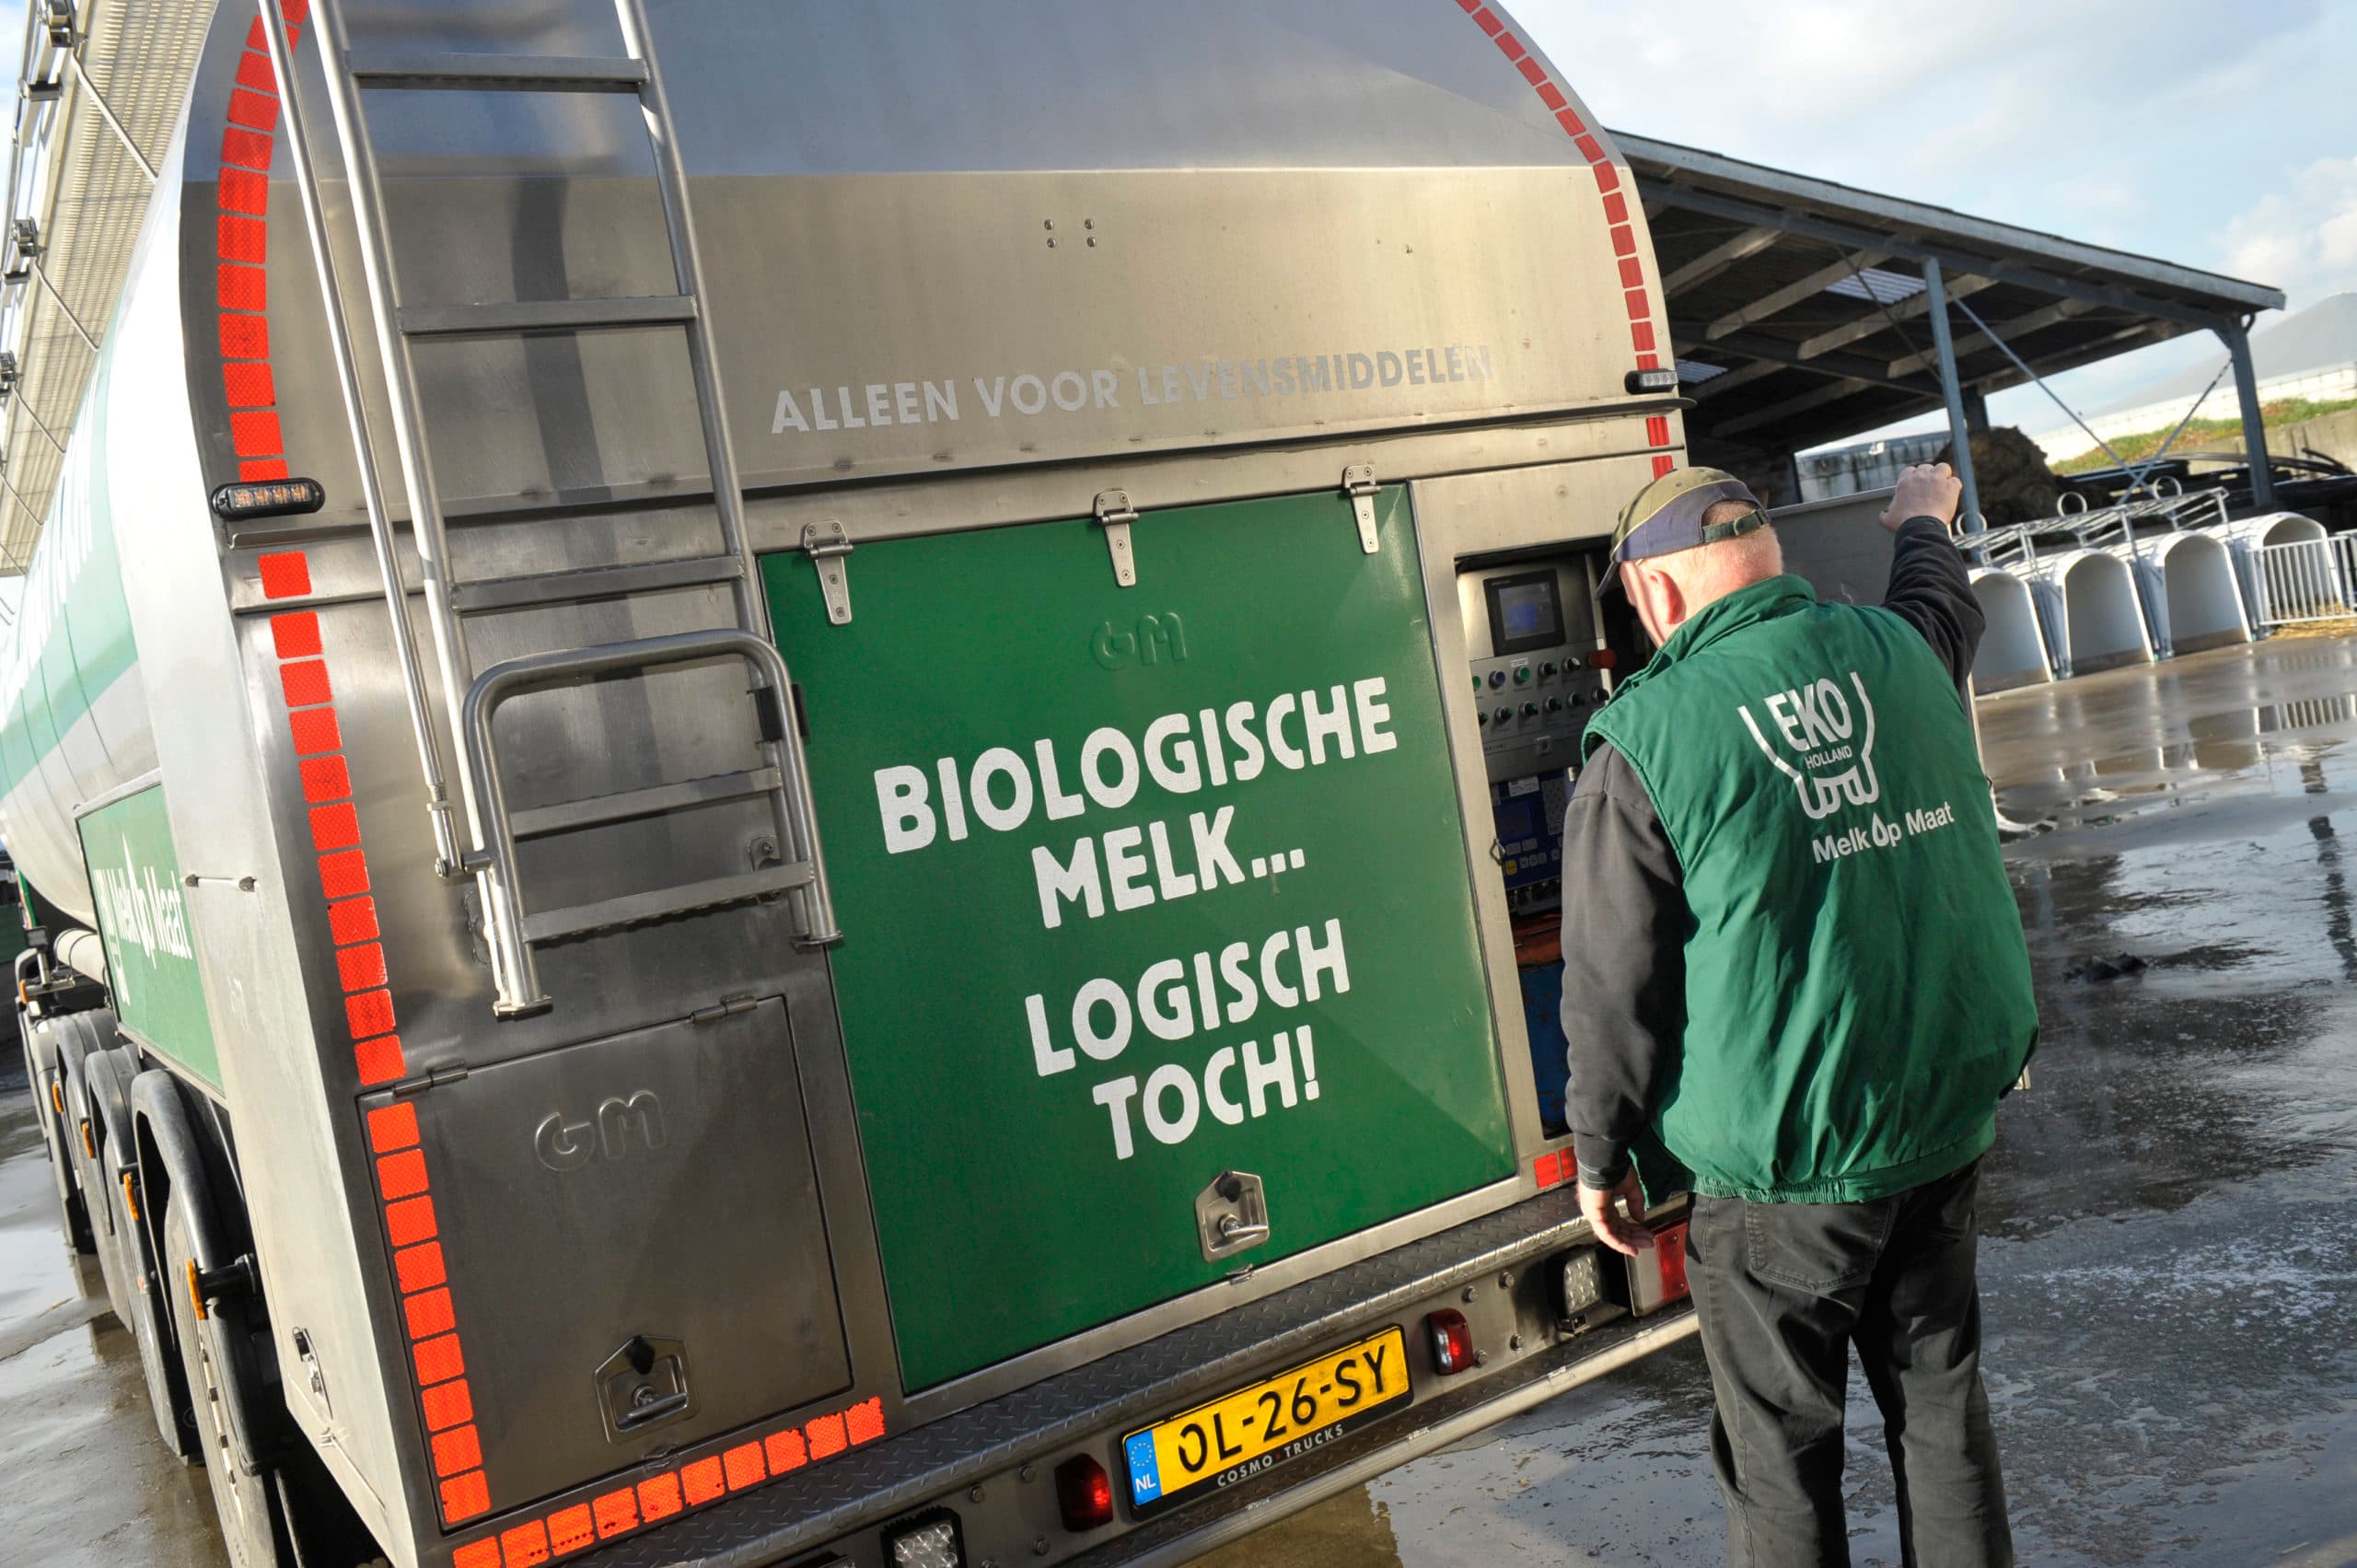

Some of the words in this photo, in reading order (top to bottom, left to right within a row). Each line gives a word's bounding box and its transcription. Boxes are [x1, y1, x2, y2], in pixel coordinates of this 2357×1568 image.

[771, 378, 960, 435] ALLEEN
[973, 369, 1120, 419] VOOR
[1137, 343, 1492, 406] LEVENSMIDDELEN
[1763, 678, 1853, 752] EKO
[1805, 745, 1853, 770] HOLLAND
[874, 676, 1398, 854] BIOLOGISCHE
[1031, 805, 1306, 929] MELK...
[1812, 827, 1872, 864] Melk
[1905, 801, 1955, 836] Maat
[1025, 918, 1350, 1076] LOGISCH
[534, 1089, 668, 1172] GM
[1092, 1024, 1320, 1160] TOCH!
[1178, 1344, 1386, 1473] OL-26-SY
[1134, 1473, 1157, 1493] NL
[1217, 1455, 1272, 1488] COSMO
[1283, 1423, 1343, 1458] TRUCKS
